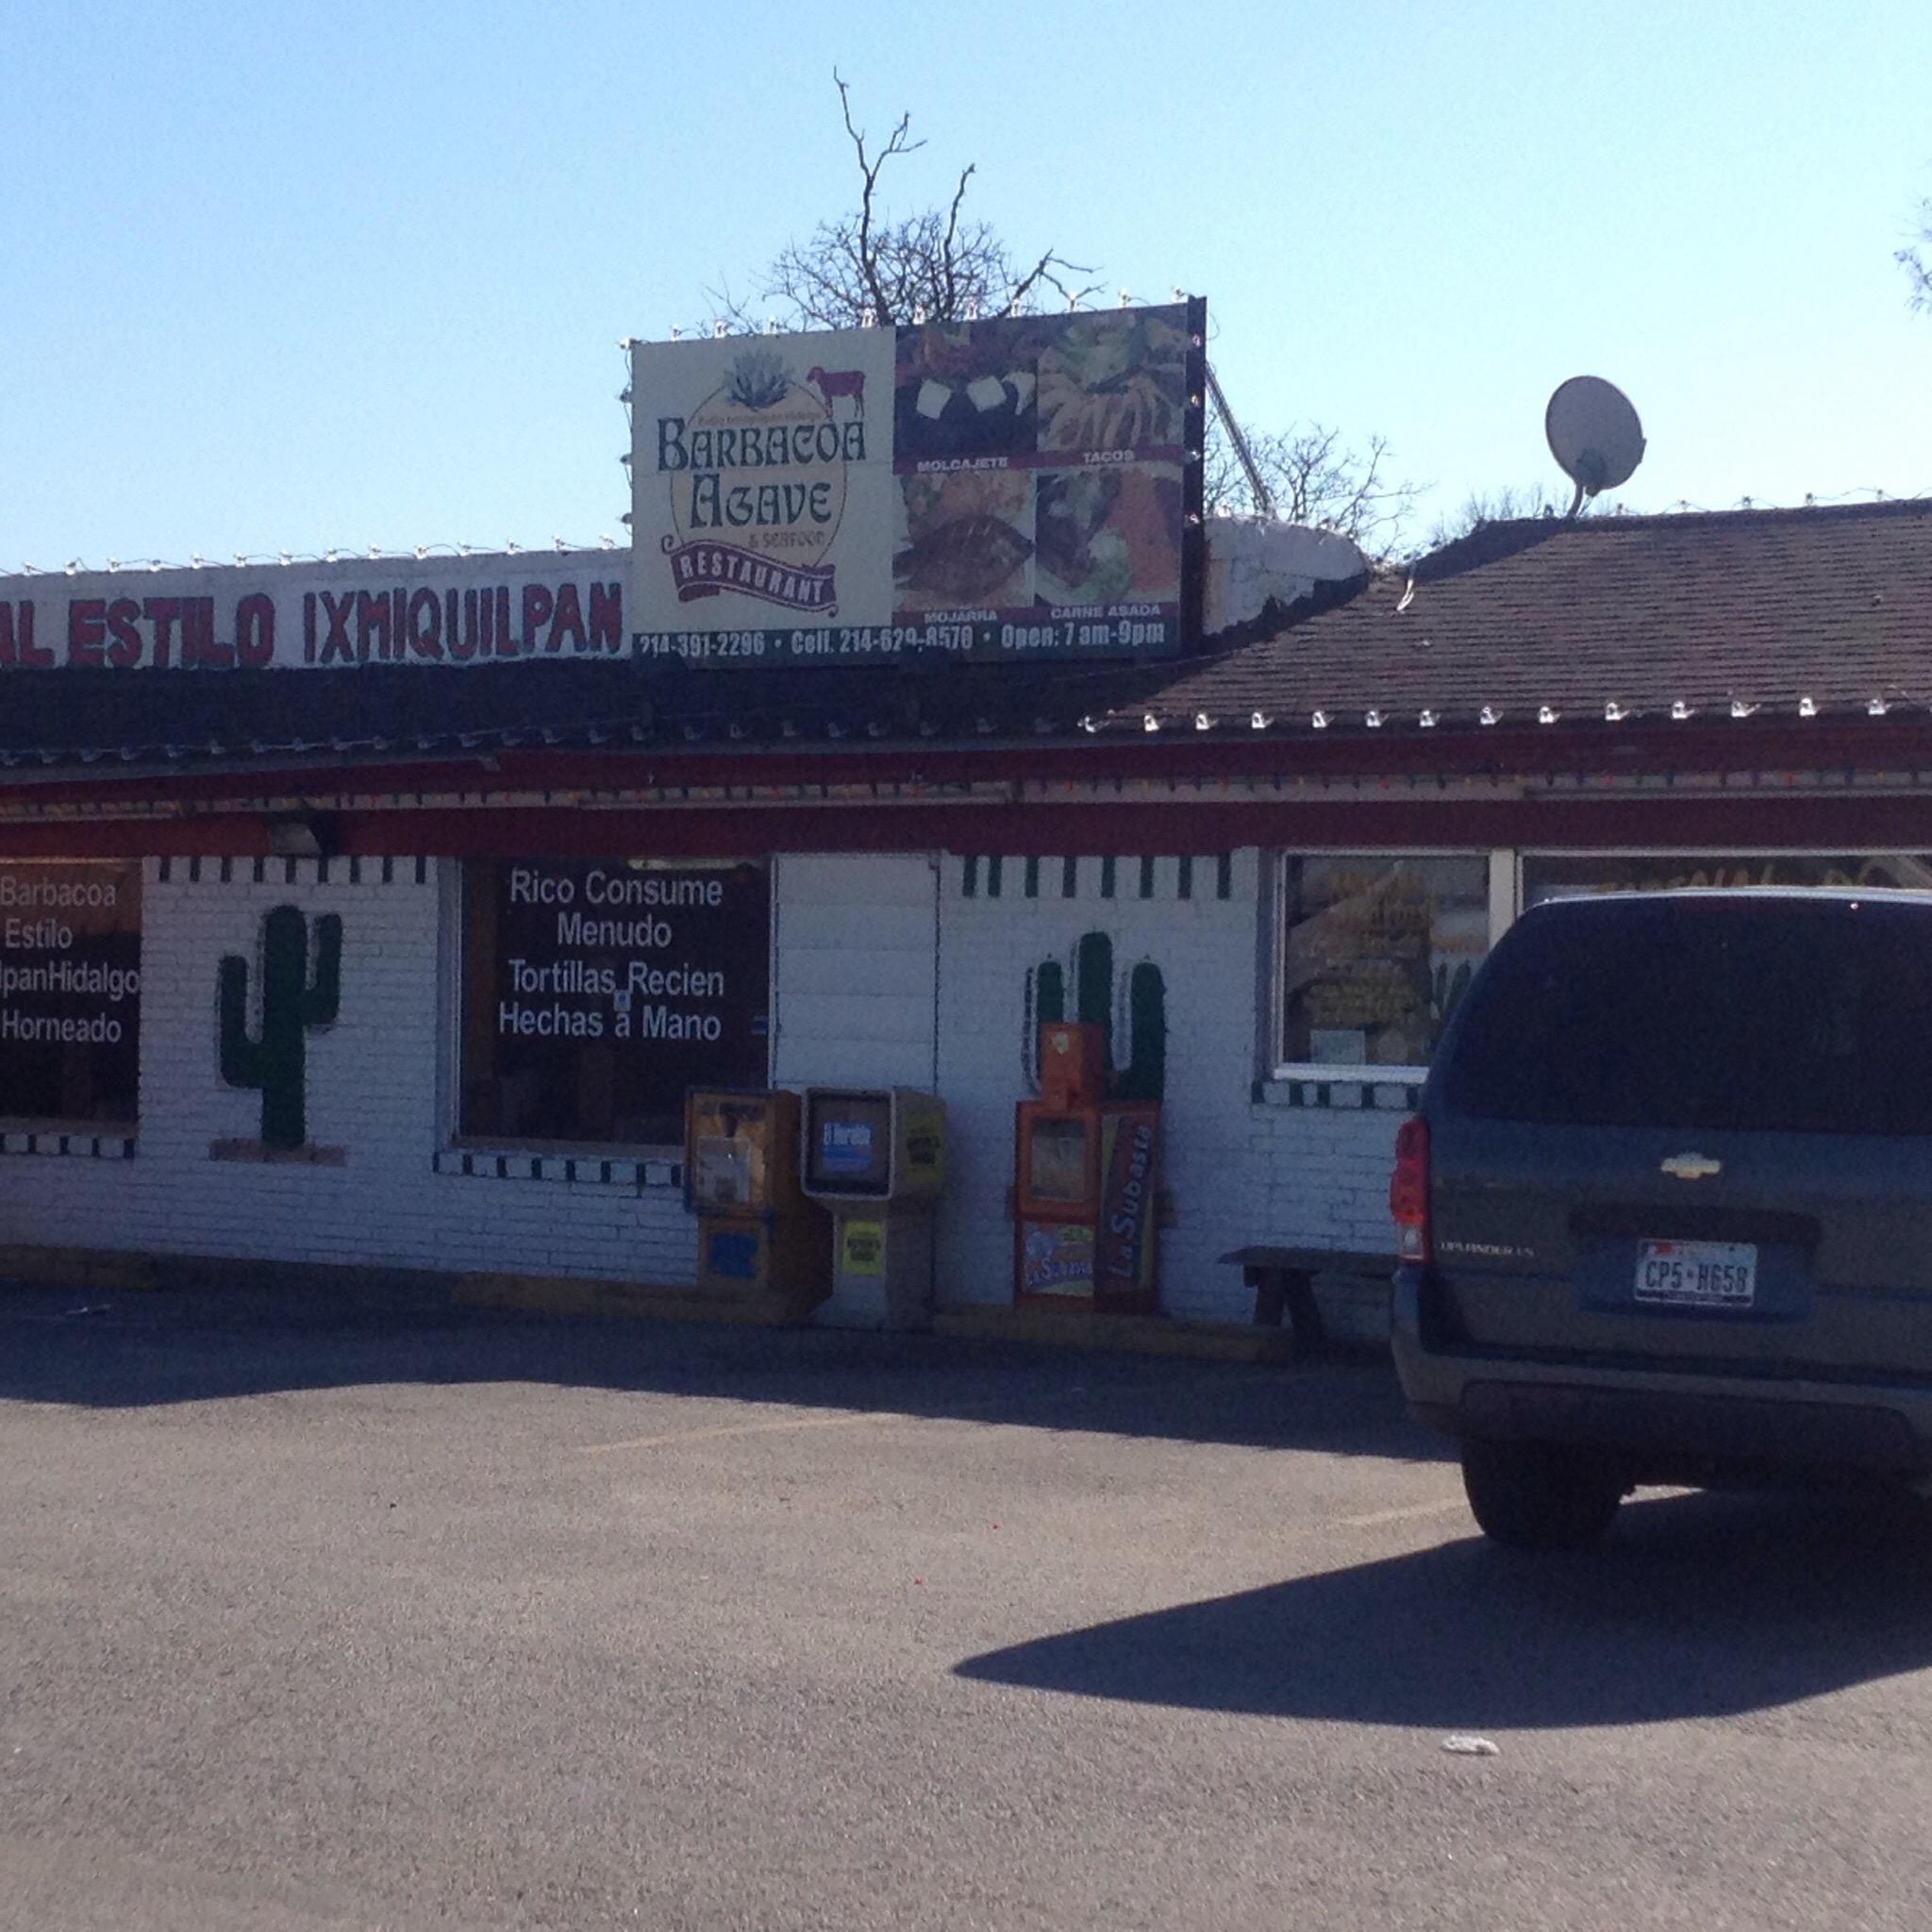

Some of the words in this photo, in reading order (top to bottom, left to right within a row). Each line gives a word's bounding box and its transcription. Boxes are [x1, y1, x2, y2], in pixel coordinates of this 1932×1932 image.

[658, 417, 866, 471] BARBACOA
[1083, 450, 1135, 463] TACOS
[917, 457, 1008, 472] MOLCAJETE
[690, 473, 833, 528] AGAVE
[679, 551, 824, 603] RESTAURANT
[68, 593, 275, 664] ESTILO
[303, 581, 623, 663] IXMIQUILPAN
[1051, 605, 1104, 619] CARNE
[1108, 603, 1161, 617] ASADA
[0, 875, 116, 906] Barbacoa
[509, 867, 575, 903] Rico
[585, 870, 724, 907] Consume
[6, 918, 73, 948] Estilo
[558, 911, 672, 947] Menudo
[508, 958, 616, 992] Tortillas
[628, 961, 724, 996] Recien
[2, 1008, 122, 1042] Horneado
[499, 1001, 604, 1038] Hechas
[642, 1005, 722, 1041] Mano
